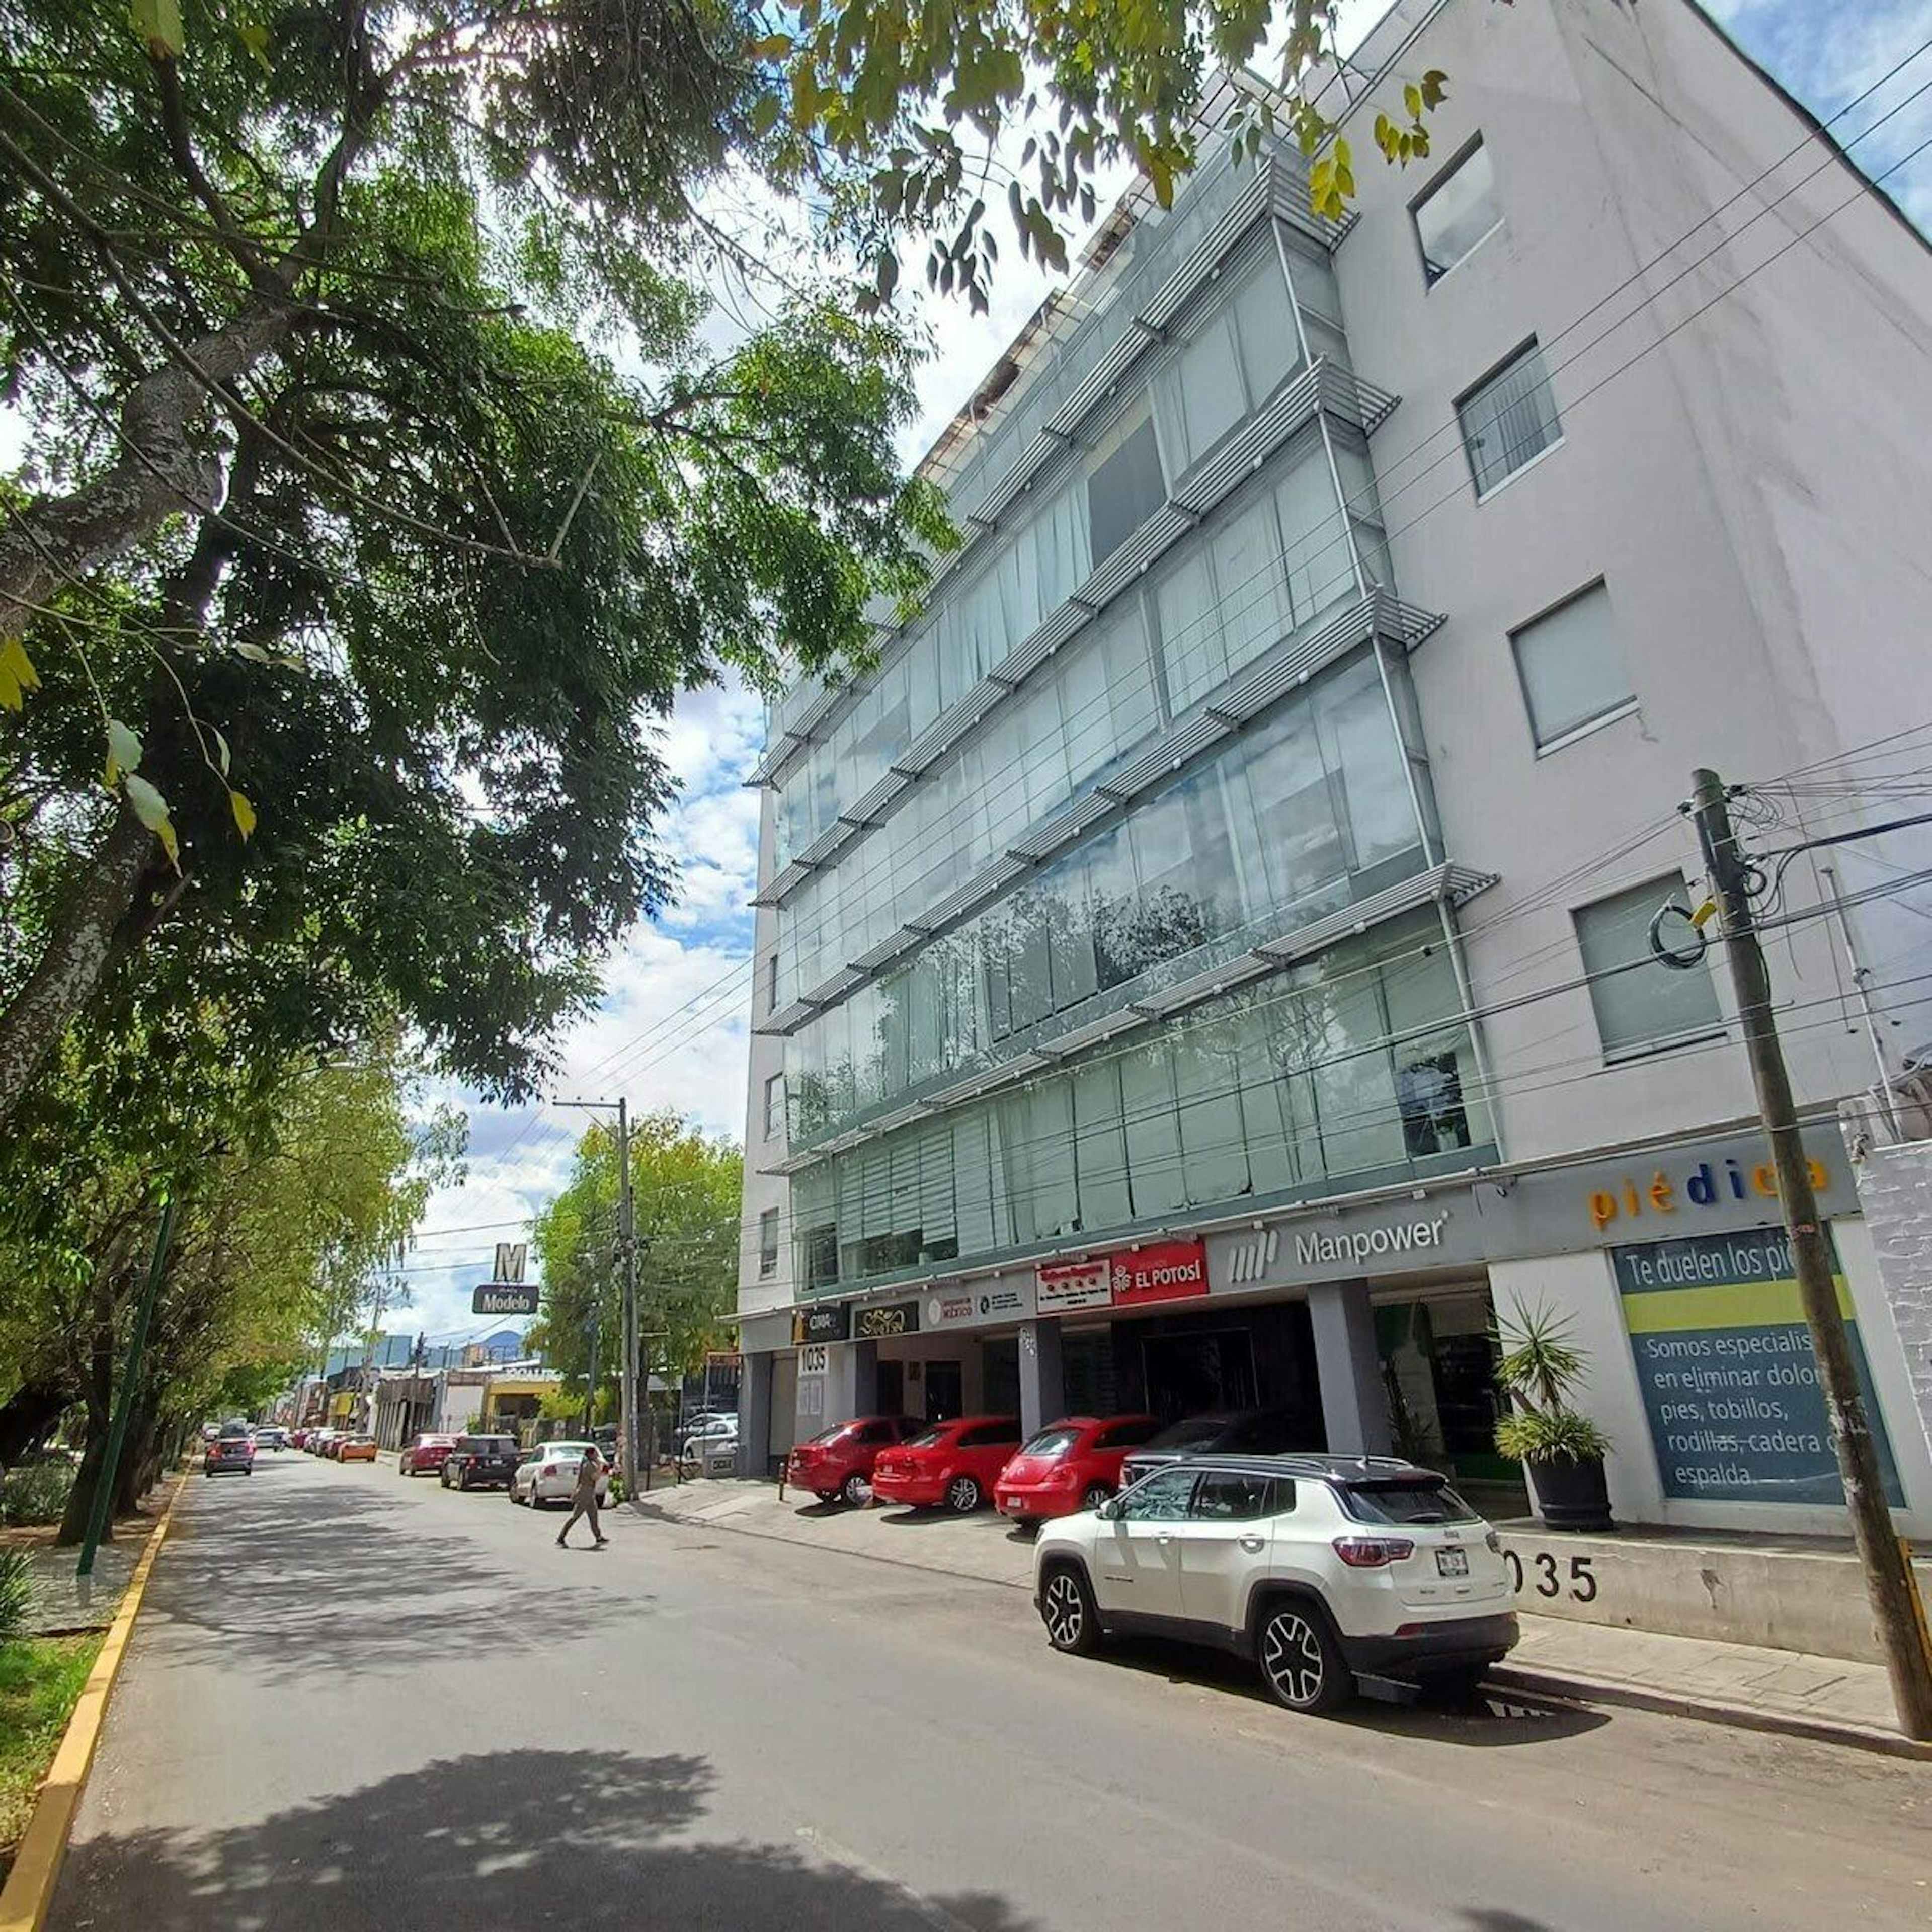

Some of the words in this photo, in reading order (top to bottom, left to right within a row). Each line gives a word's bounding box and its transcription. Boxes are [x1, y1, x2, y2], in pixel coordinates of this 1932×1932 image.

[1295, 1217, 1444, 1263] Manpower
[494, 1243, 526, 1282] M
[1626, 1255, 1653, 1285] Te
[1657, 1248, 1726, 1282] duelen
[1727, 1242, 1762, 1276] los
[1136, 1271, 1151, 1288] EL
[483, 1294, 529, 1312] Modelo
[1647, 1339, 1711, 1358] Somos
[1654, 1373, 1678, 1389] en
[1682, 1366, 1760, 1388] eliminar
[1661, 1400, 1705, 1425] pies,
[1708, 1397, 1789, 1421] tobillos,
[1667, 1429, 1744, 1454] rodillas,
[1748, 1429, 1821, 1452] cadera
